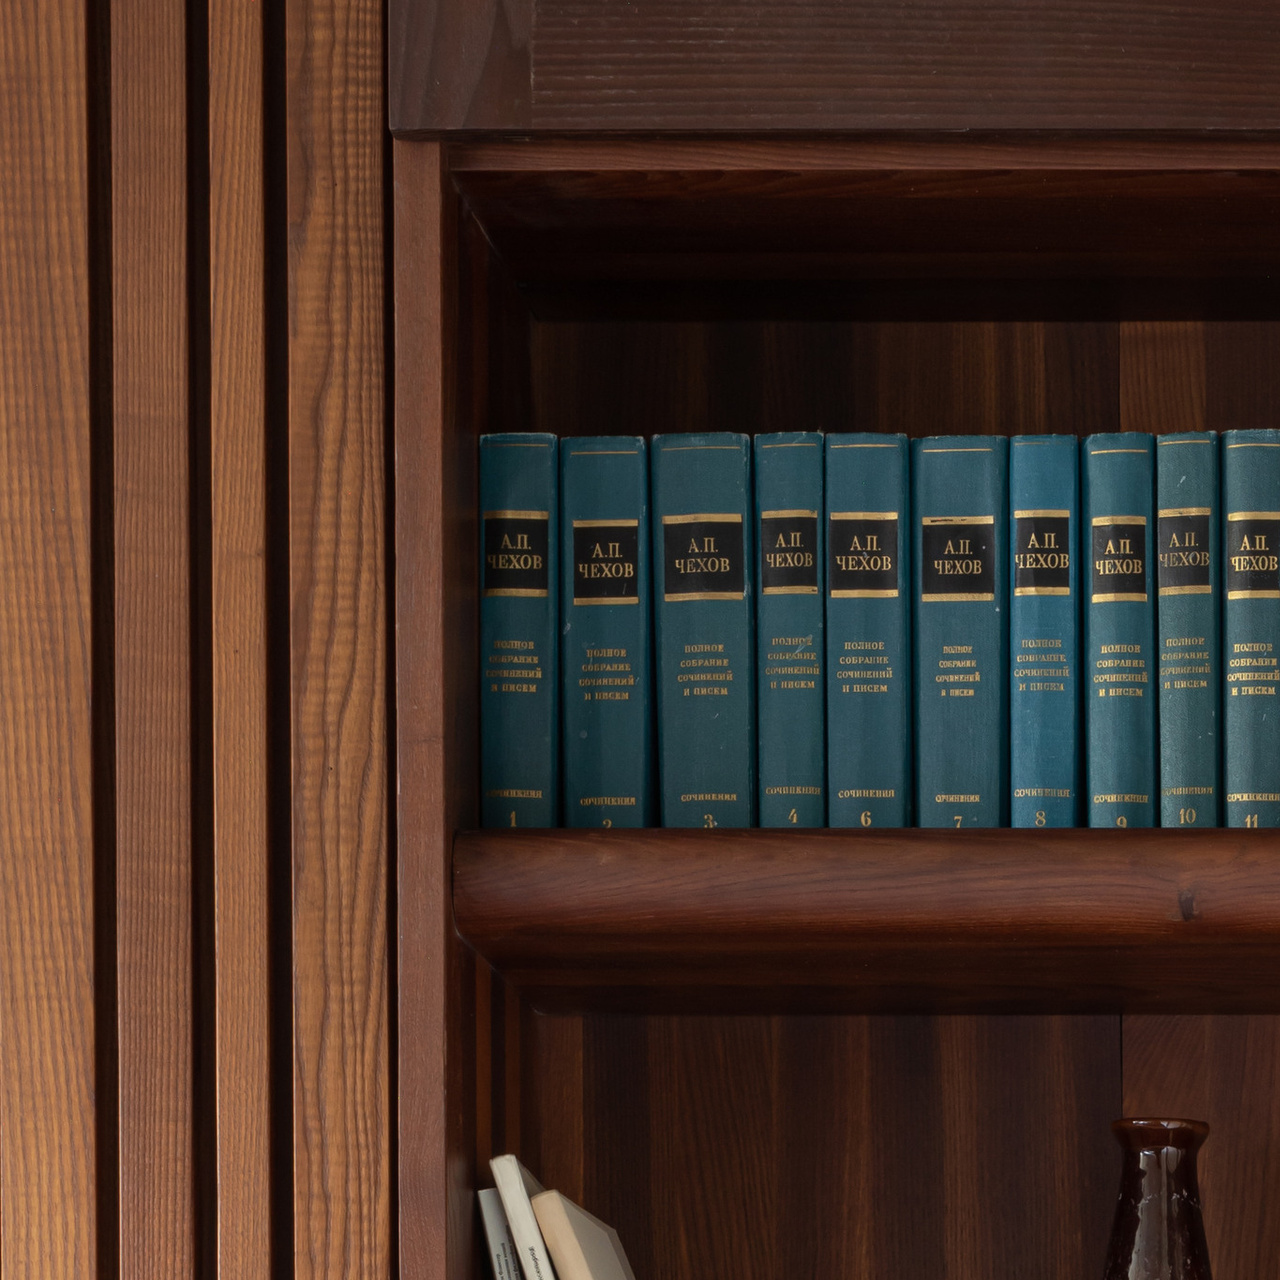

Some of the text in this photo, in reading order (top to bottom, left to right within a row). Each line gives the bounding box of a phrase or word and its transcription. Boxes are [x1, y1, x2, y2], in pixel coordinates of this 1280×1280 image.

[502, 533, 532, 550] А.П.
[688, 537, 720, 553] А.П.
[775, 531, 802, 548] А.П.
[850, 534, 879, 552] А.П.
[943, 539, 975, 555] А.П.
[1027, 532, 1060, 549] А.П.
[1104, 538, 1134, 556] А.П.
[1169, 532, 1198, 548] А.П.
[1239, 534, 1270, 551] А.П.
[591, 541, 623, 559] А.П.
[487, 553, 543, 570] ЧЕХОВ
[674, 557, 731, 574] ЧЕХОВ
[765, 552, 813, 568] ЧЕХОВ
[836, 555, 892, 571] ЧЕХОВ
[933, 559, 983, 575] ЧЕХОВ
[1015, 552, 1070, 569] ЧЕХОВ
[1095, 558, 1142, 576] ЧЕХОВ
[1159, 551, 1210, 567] ЧЕХОВ
[1229, 555, 1278, 572] ЧЕХОВ
[578, 562, 634, 578] ЧЕХОВ
[843, 641, 885, 651] ПОЛНОЕ
[839, 655, 889, 665] СОБРАНИЕ
[836, 666, 893, 679] СОЧИНЕНИЙ
[852, 684, 888, 693] ПИСЕМ
[838, 789, 895, 799] СОЧИНЕНИЯ
[509, 811, 517, 828] 1
[703, 813, 715, 828] 3
[788, 808, 798, 824] 4
[860, 811, 872, 827] 6
[953, 815, 963, 828] 7
[1034, 810, 1047, 828] 8
[1179, 808, 1197, 825] 10
[1245, 815, 1258, 828] 11
